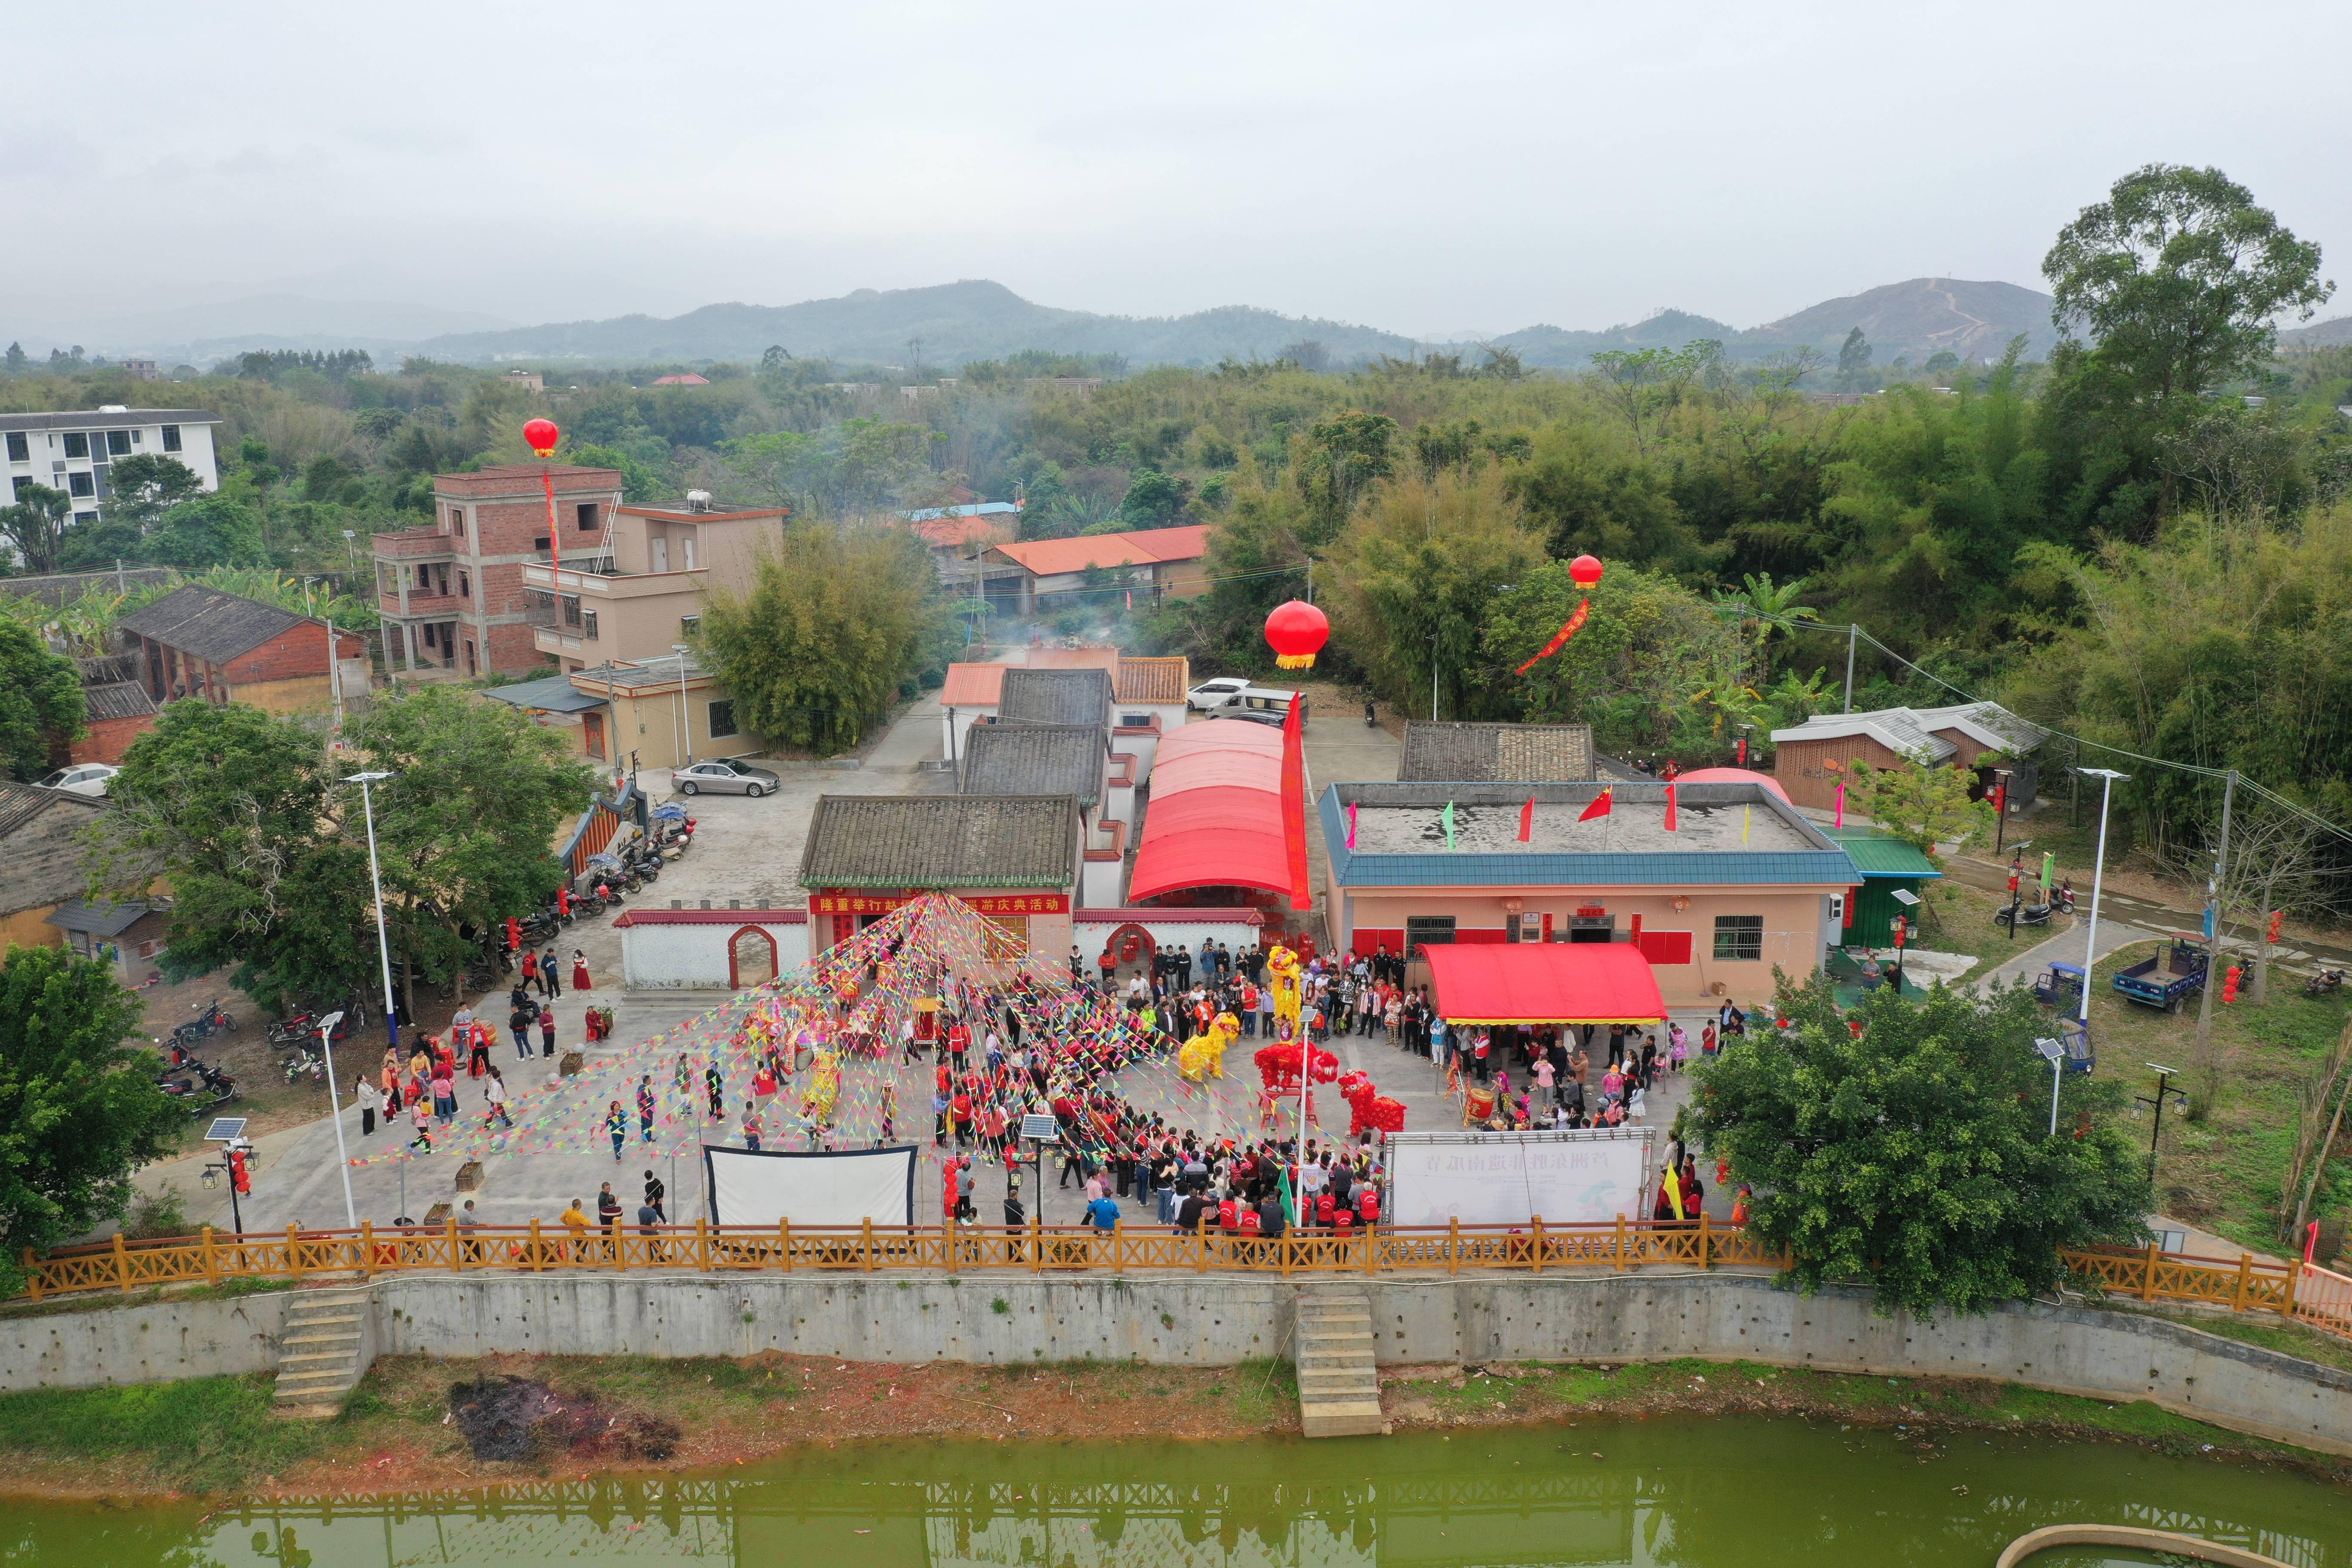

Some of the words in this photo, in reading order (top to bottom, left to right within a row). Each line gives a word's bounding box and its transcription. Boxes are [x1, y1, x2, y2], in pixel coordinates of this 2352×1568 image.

[820, 898, 1058, 911] 隆重举行赵巡游庆典活动
